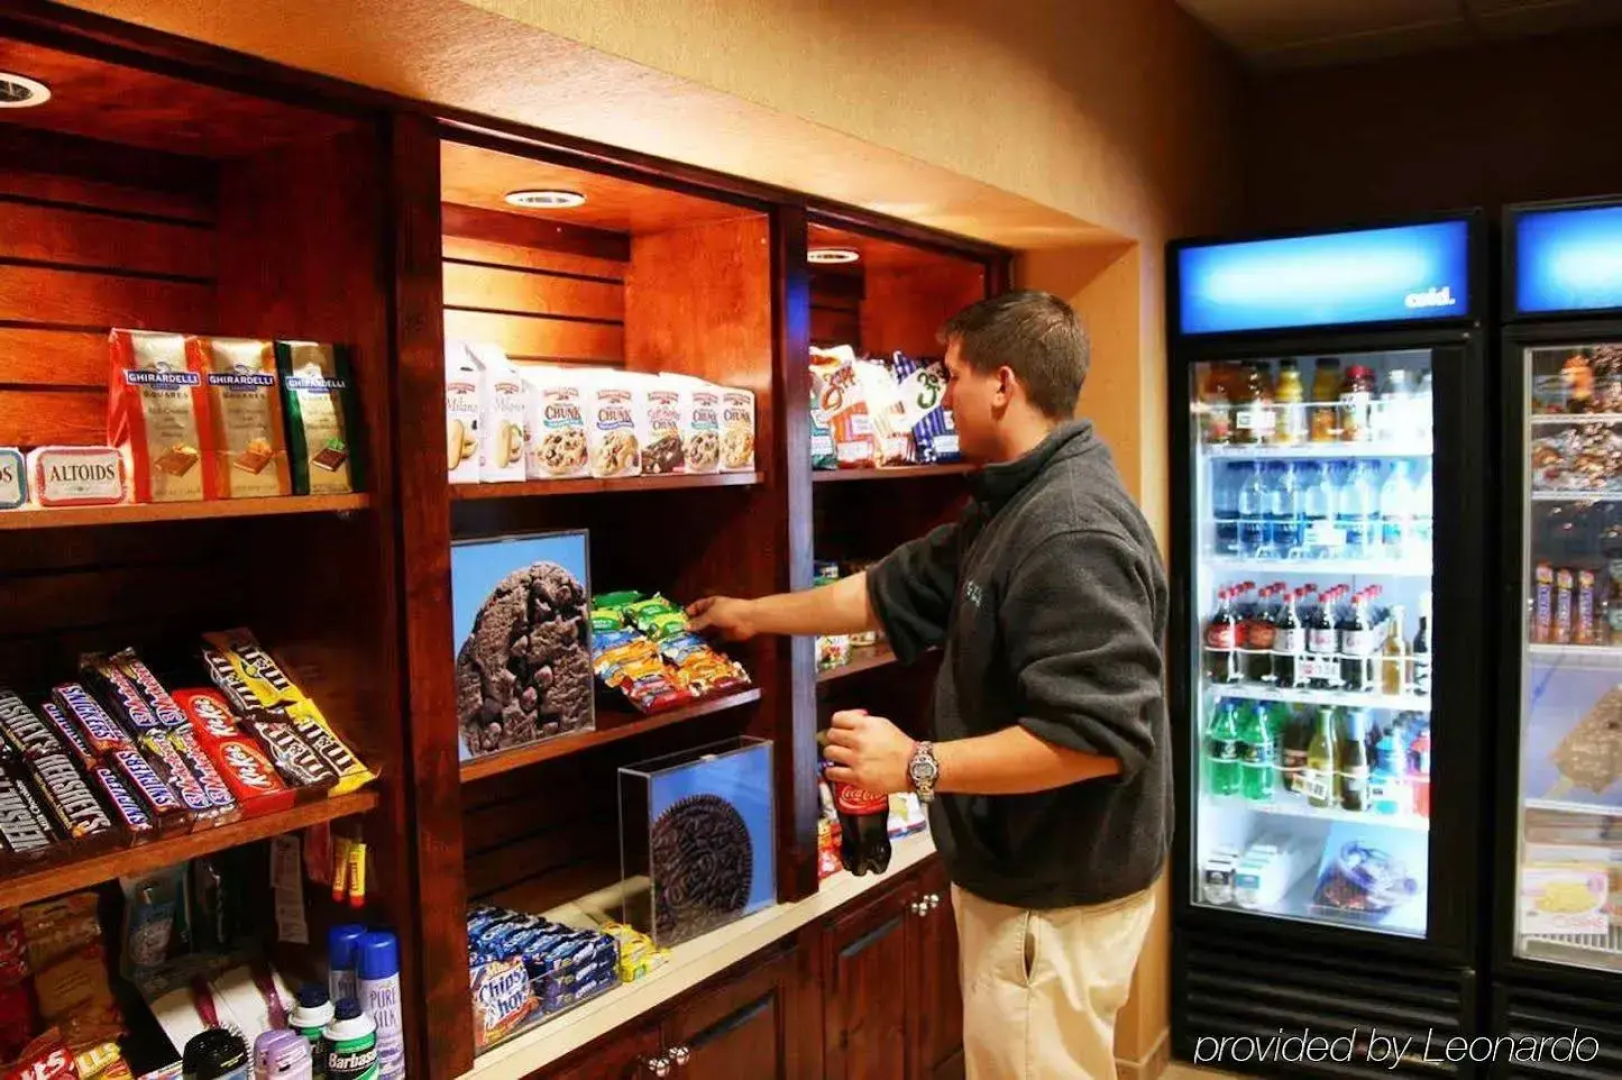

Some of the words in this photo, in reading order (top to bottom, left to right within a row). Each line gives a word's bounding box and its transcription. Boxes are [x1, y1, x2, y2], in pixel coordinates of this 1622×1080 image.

[128, 372, 198, 385] GHIRARDELLI
[209, 375, 273, 386] GHIRARDELLI
[50, 464, 115, 482] ALTOIDS
[65, 686, 113, 741] SNICKERS
[119, 750, 174, 806] SNICKERS
[34, 753, 112, 834] HERSHEY'S
[370, 987, 395, 1009] PURE
[479, 970, 522, 1006] Chips
